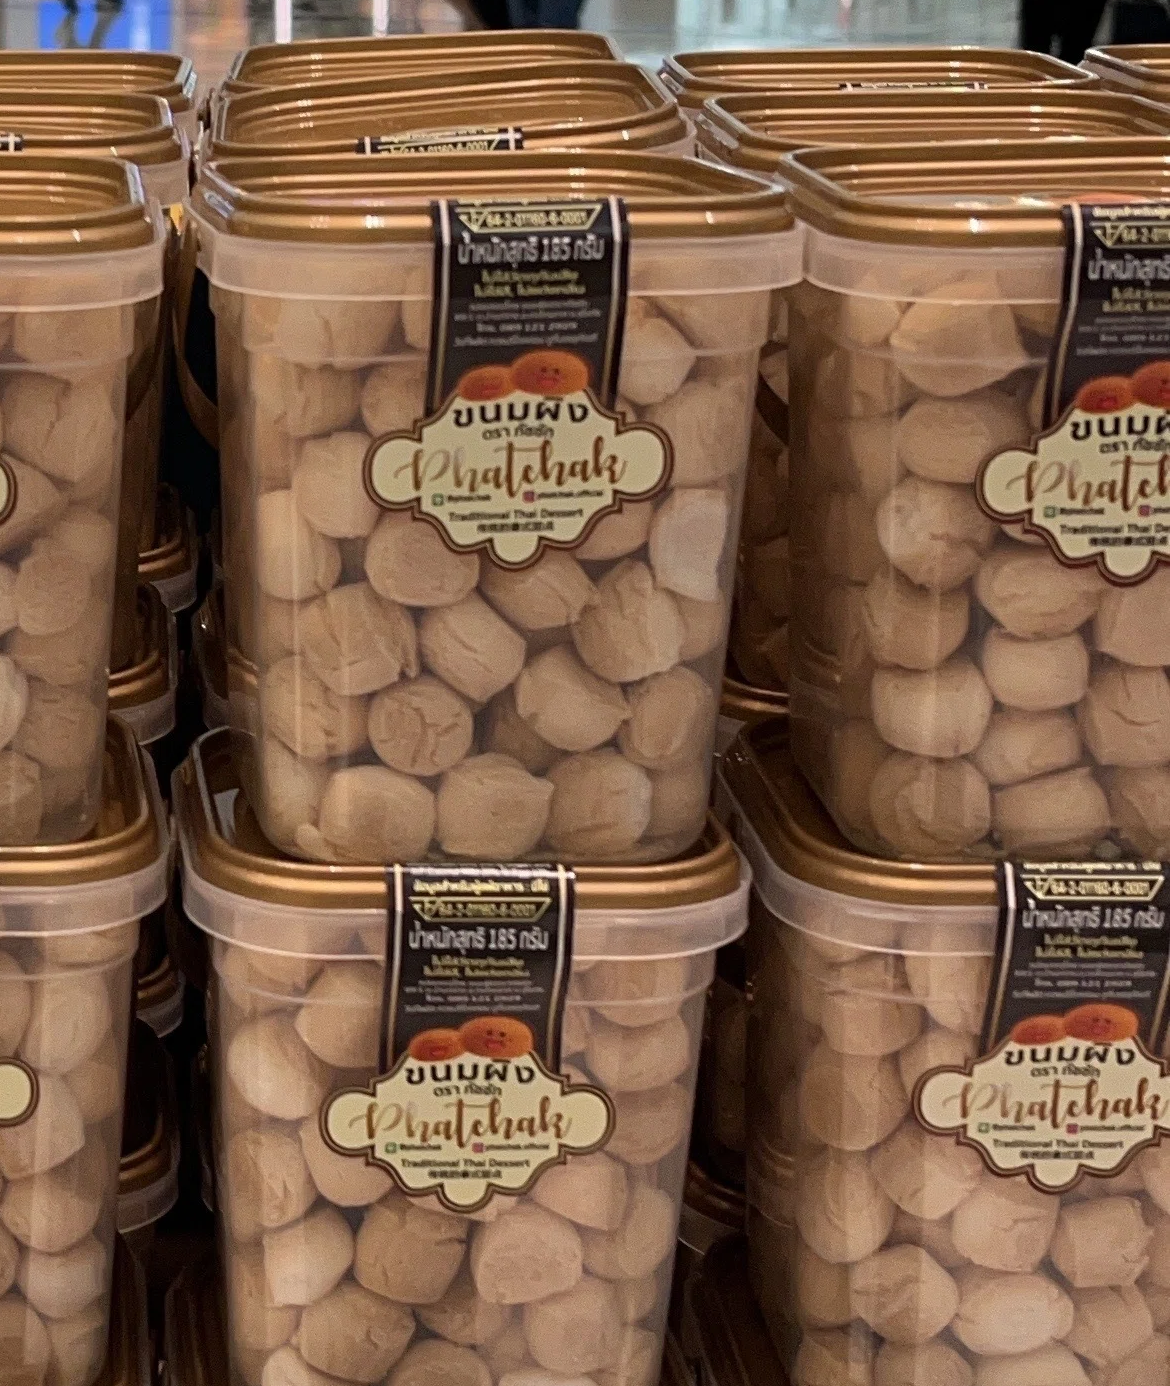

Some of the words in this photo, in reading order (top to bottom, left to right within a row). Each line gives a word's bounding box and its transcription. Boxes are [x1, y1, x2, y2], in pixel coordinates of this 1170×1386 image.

[541, 237, 571, 261] 185
[453, 396, 589, 427] ขนมผิง
[394, 435, 627, 498] Phatchak
[449, 512, 510, 522] Traditional
[513, 510, 538, 519] Thai
[1104, 908, 1132, 928] 185
[489, 928, 517, 950] 185
[1005, 1043, 1134, 1065] ขนมผิง
[406, 1058, 535, 1084] ขนมผิง
[942, 1077, 1170, 1128] Phatchak
[348, 1096, 572, 1147] Phatchak
[994, 1139, 1052, 1148] Traditional
[1056, 1139, 1079, 1147] Thai
[401, 1158, 460, 1168] Traditional
[463, 1158, 486, 1167] Thai
